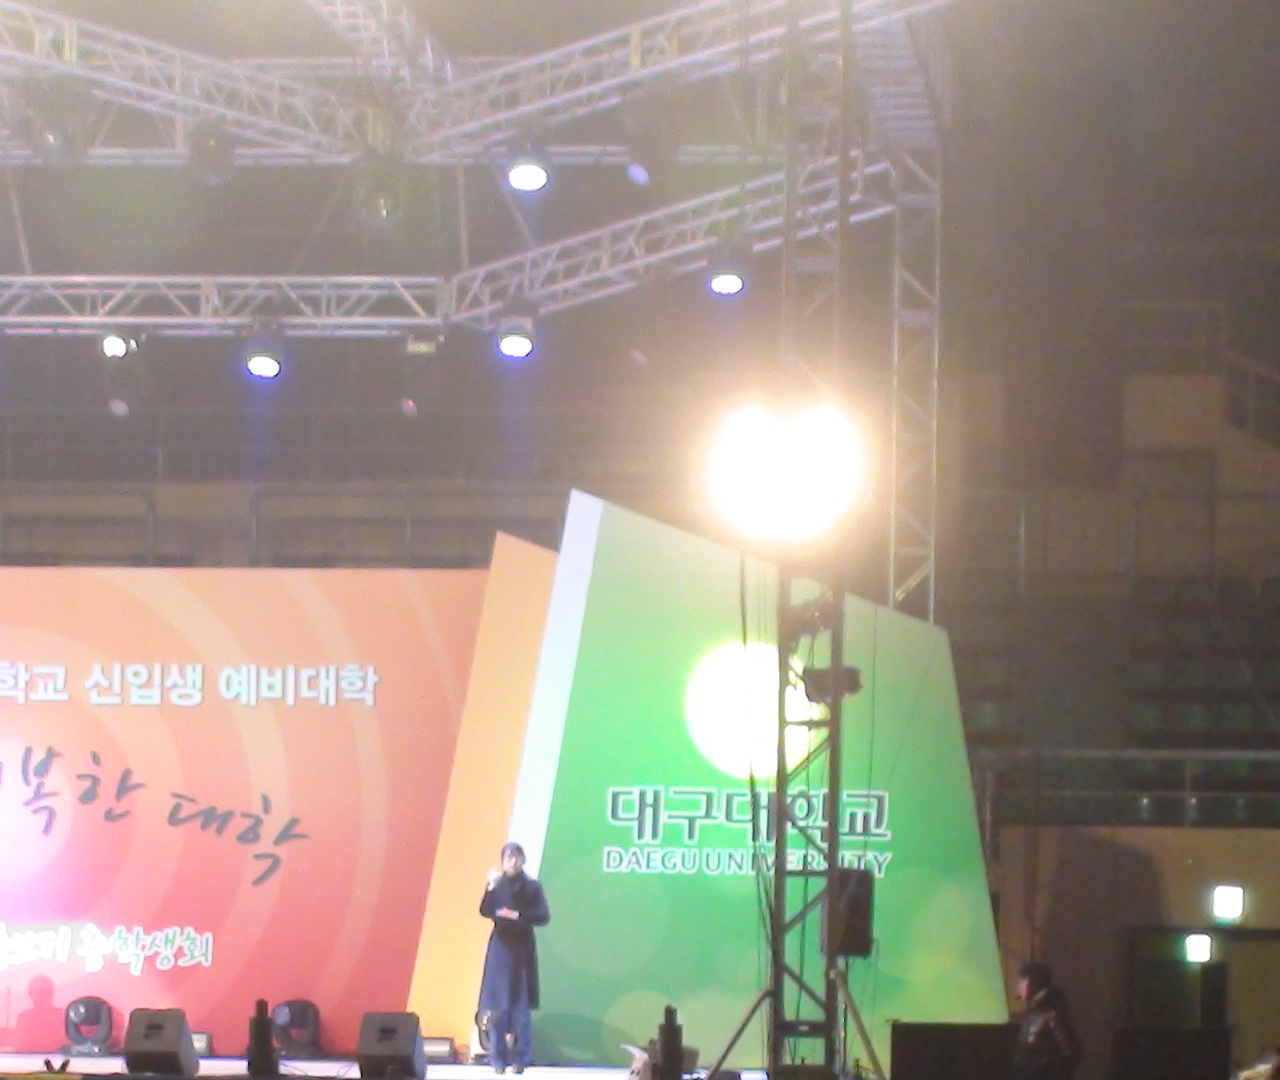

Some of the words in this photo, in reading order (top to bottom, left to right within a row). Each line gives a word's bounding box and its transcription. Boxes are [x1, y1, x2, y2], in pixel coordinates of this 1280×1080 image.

[83, 662, 204, 707] 신입생
[217, 664, 379, 707] 예비대학
[167, 794, 310, 886] 대학
[602, 846, 697, 874] DAEGU
